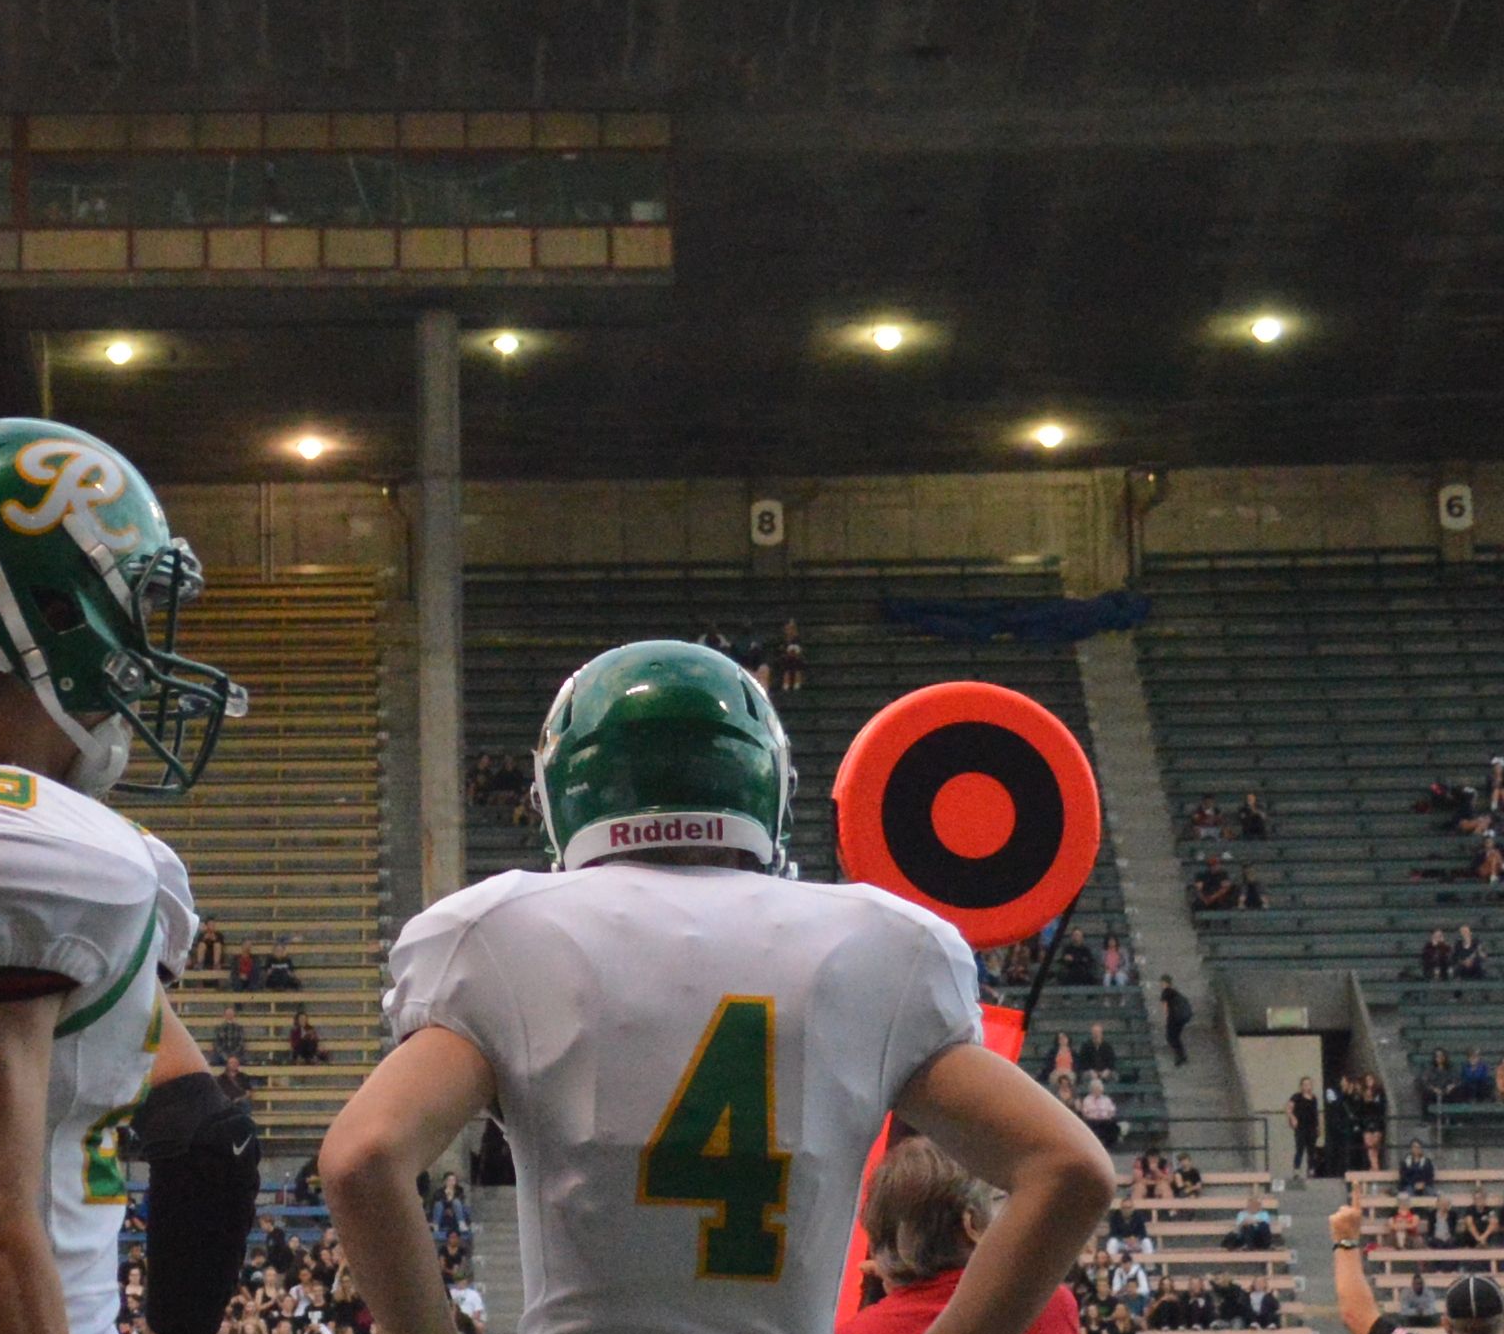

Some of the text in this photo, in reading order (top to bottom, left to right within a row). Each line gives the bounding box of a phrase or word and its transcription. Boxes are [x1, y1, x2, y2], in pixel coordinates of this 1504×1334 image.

[1446, 495, 1466, 518] 6
[757, 511, 776, 535] 8
[609, 817, 724, 848] Riddell
[636, 993, 792, 1282] 4
